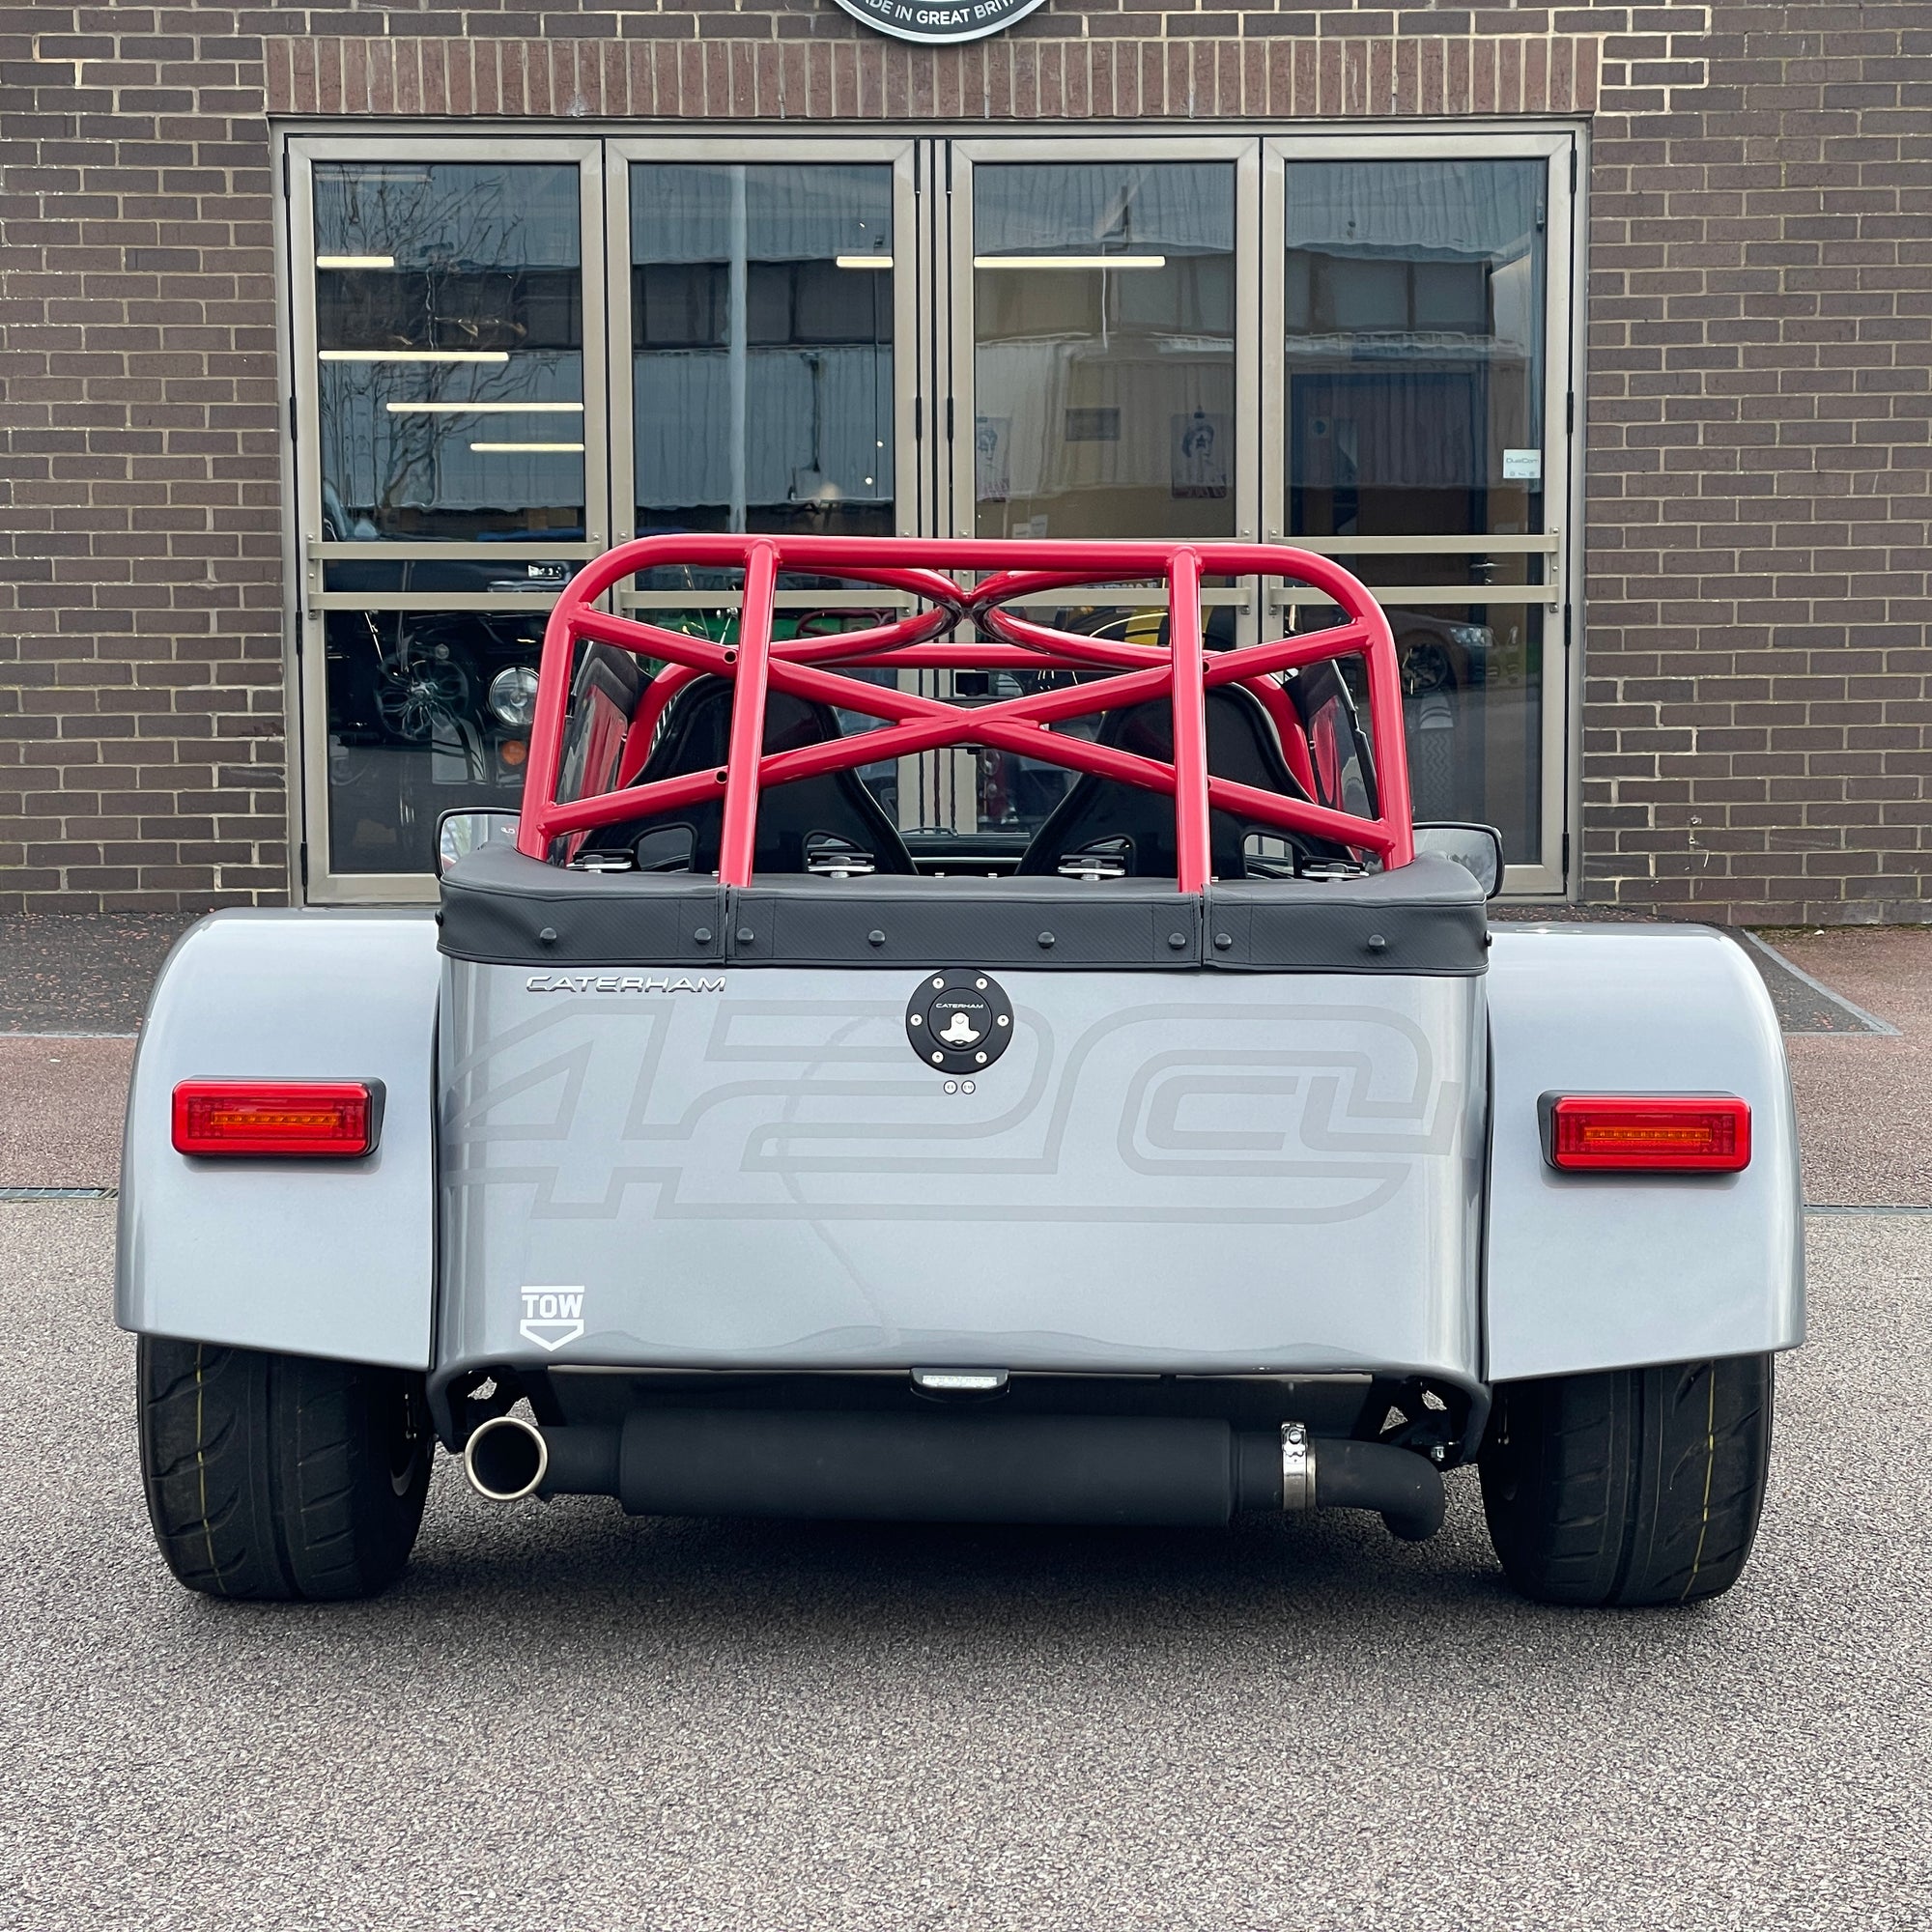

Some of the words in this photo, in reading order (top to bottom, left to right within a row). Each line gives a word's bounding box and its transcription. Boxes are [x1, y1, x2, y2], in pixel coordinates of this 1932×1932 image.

[895, 4, 913, 21] IN
[917, 8, 971, 25] GREAT
[973, 0, 1013, 20] BRI
[526, 976, 727, 993] CATERHAM
[522, 1293, 583, 1319] TOW
